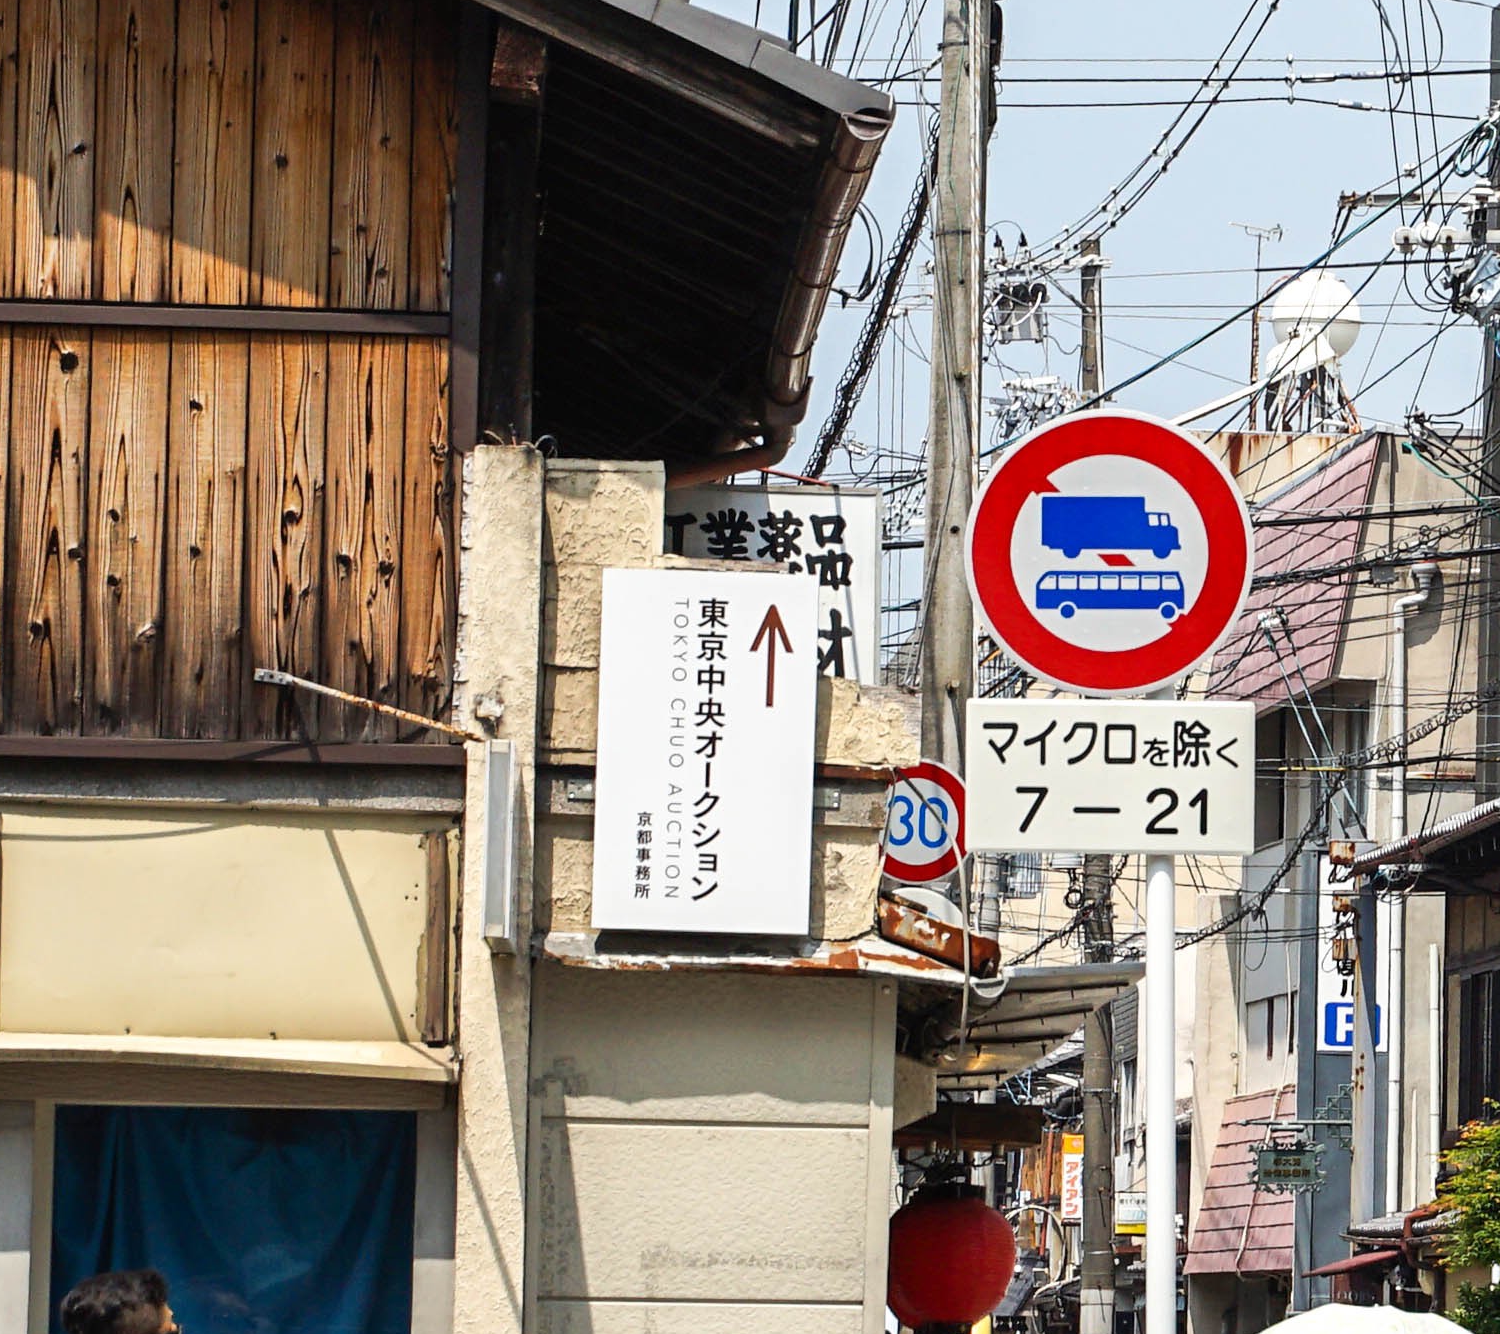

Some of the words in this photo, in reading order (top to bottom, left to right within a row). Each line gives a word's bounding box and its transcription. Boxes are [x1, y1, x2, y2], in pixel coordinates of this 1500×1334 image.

[672, 598, 690, 683] TOKYO
[668, 697, 687, 768] CHUO
[691, 598, 730, 902] 東京中央オークション
[982, 719, 1240, 768] マイクロを除く
[633, 811, 653, 900] 京都事務所
[664, 782, 683, 899] AUCTION
[887, 795, 949, 849] 30
